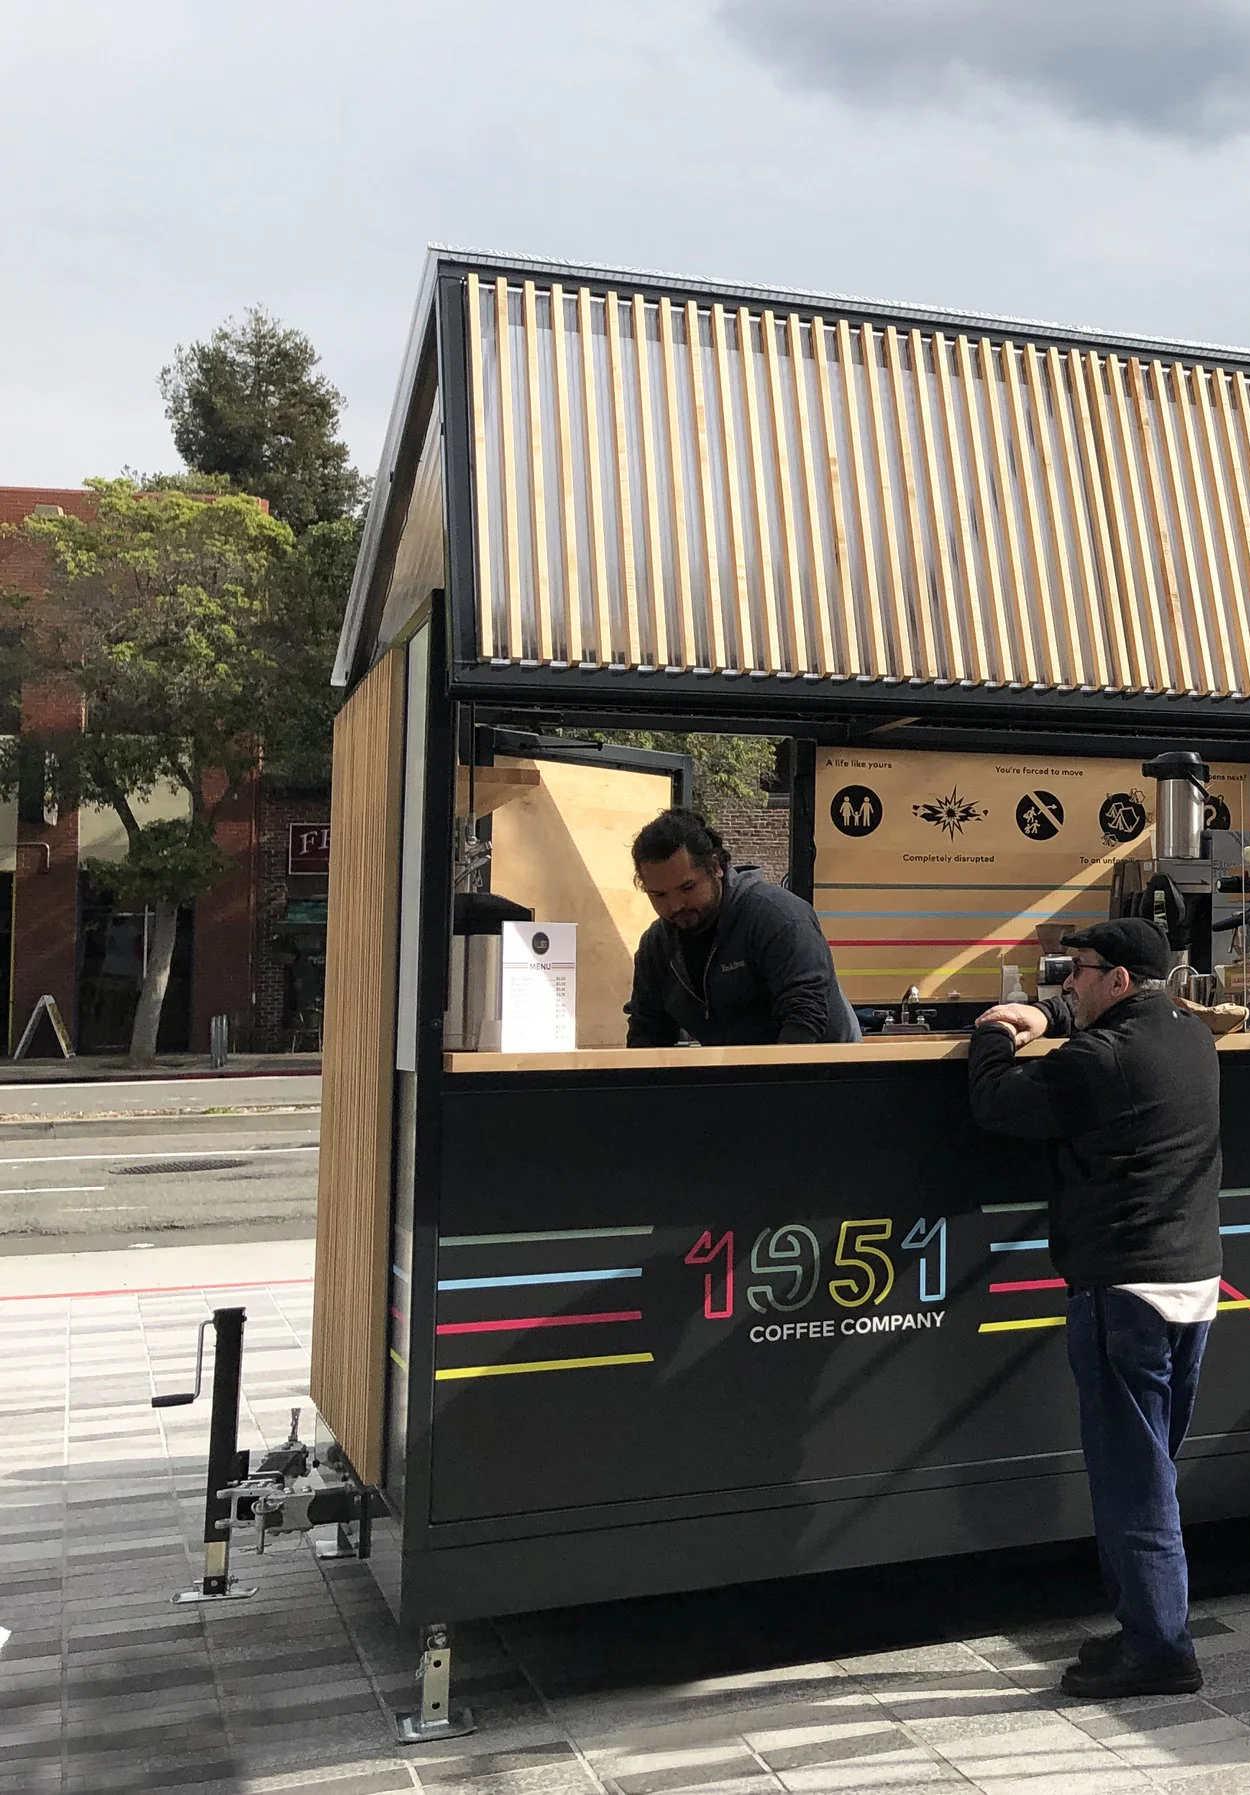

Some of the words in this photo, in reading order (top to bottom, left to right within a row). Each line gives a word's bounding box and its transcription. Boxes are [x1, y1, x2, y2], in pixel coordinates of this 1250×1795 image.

[825, 759, 833, 767] A
[835, 759, 849, 768] life
[851, 760, 866, 768] like
[868, 761, 893, 770] yours
[995, 765, 1021, 774] You're
[1022, 766, 1049, 775] forced
[1051, 768, 1060, 776] to
[1061, 769, 1084, 777] move
[902, 853, 953, 864] Completely
[953, 854, 995, 864] disrupted
[1079, 856, 1089, 864] To
[529, 962, 552, 971] MENU
[684, 1217, 947, 1320] 1951
[749, 1319, 835, 1344] COFFEE
[840, 1310, 946, 1336] COMPANY
